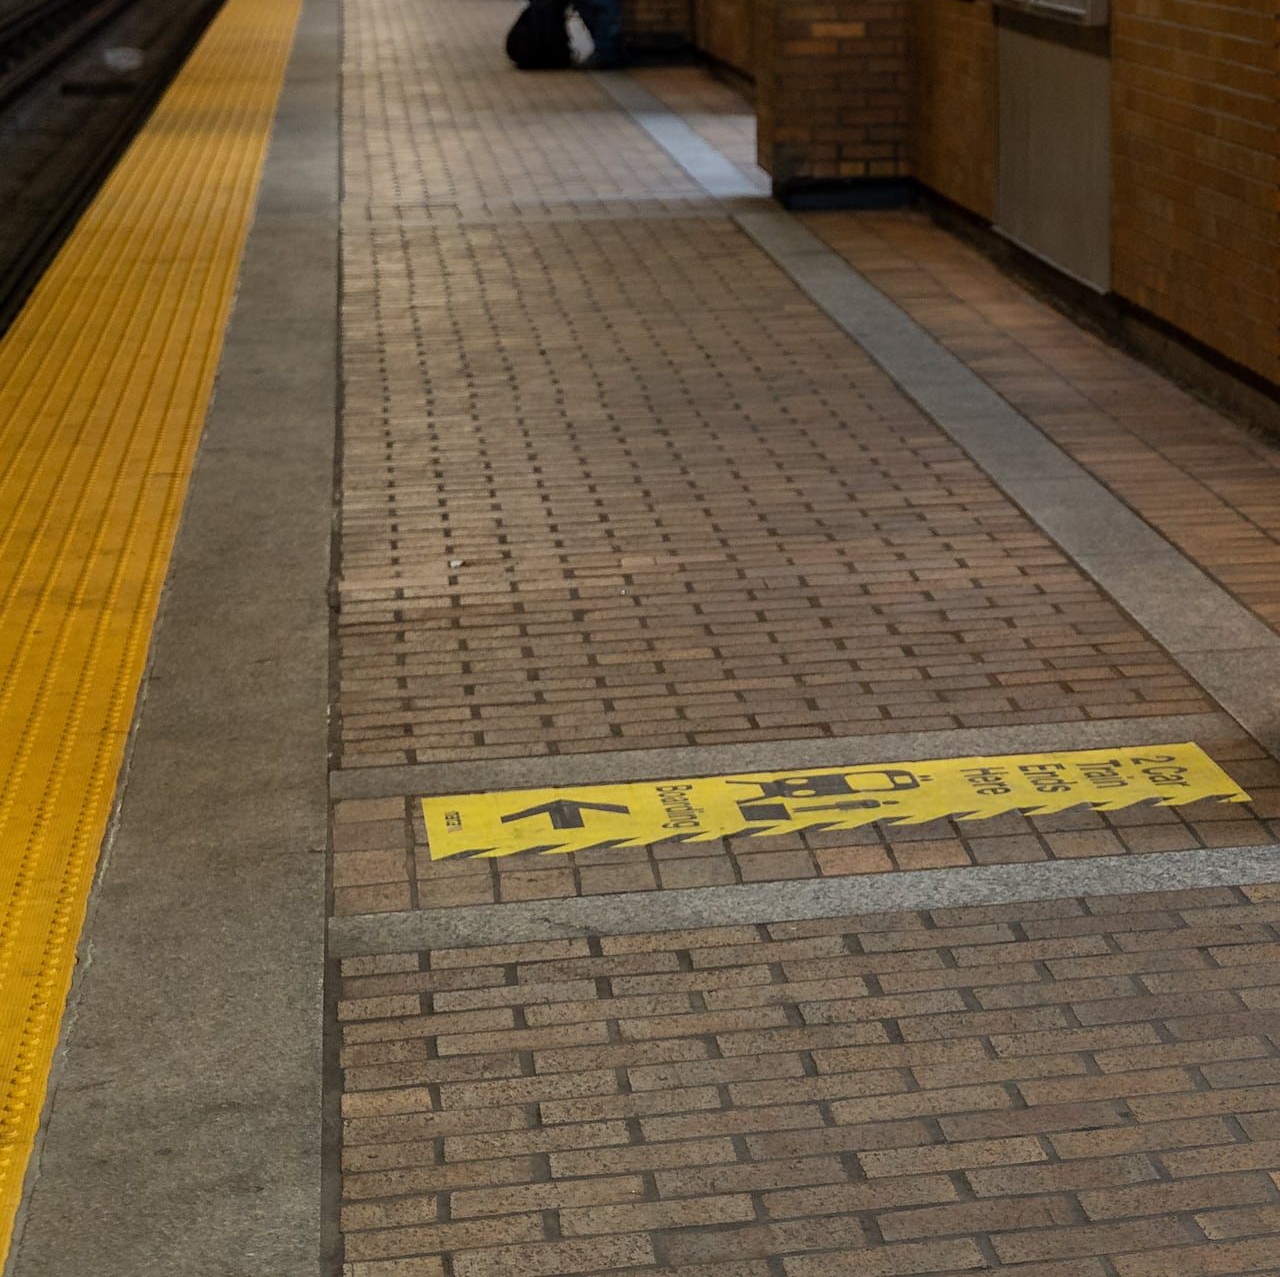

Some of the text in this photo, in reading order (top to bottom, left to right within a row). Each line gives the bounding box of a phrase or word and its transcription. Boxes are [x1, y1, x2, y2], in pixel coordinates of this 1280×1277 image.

[960, 766, 1011, 796] Here
[1018, 764, 1078, 793] Ends
[1077, 759, 1129, 789] Train
[1131, 755, 1191, 787] 2 Car
[656, 784, 704, 829] Boarding
